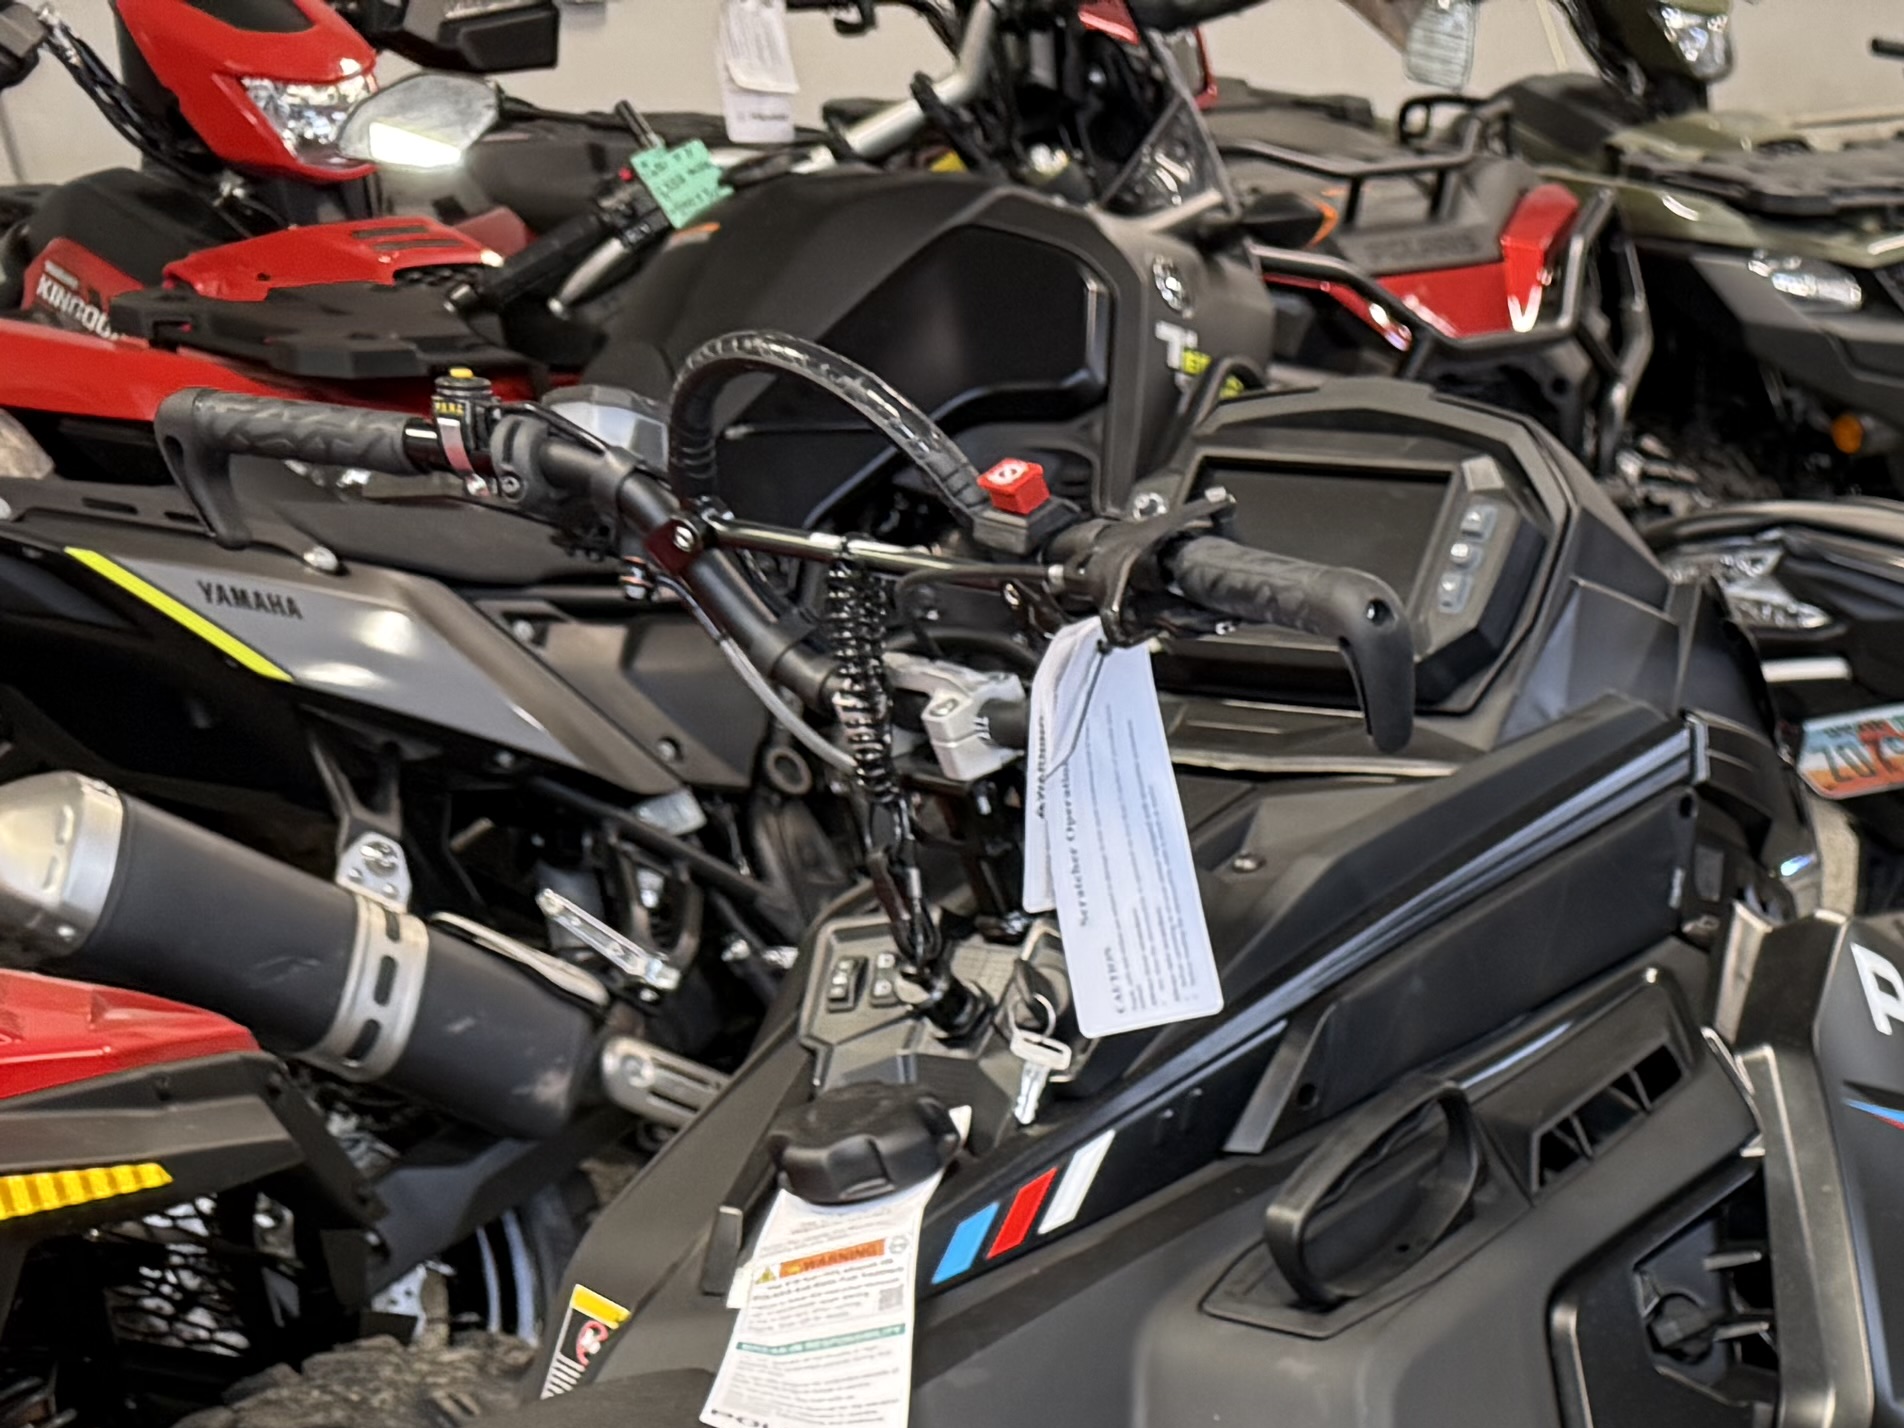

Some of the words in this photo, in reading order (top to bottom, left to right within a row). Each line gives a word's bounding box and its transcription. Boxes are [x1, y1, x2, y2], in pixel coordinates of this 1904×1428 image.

[197, 579, 303, 619] YAMAHA
[1070, 847, 1088, 928] Scratcher
[1104, 947, 1125, 1014] CAUTION
[803, 1244, 879, 1271] WARNING
